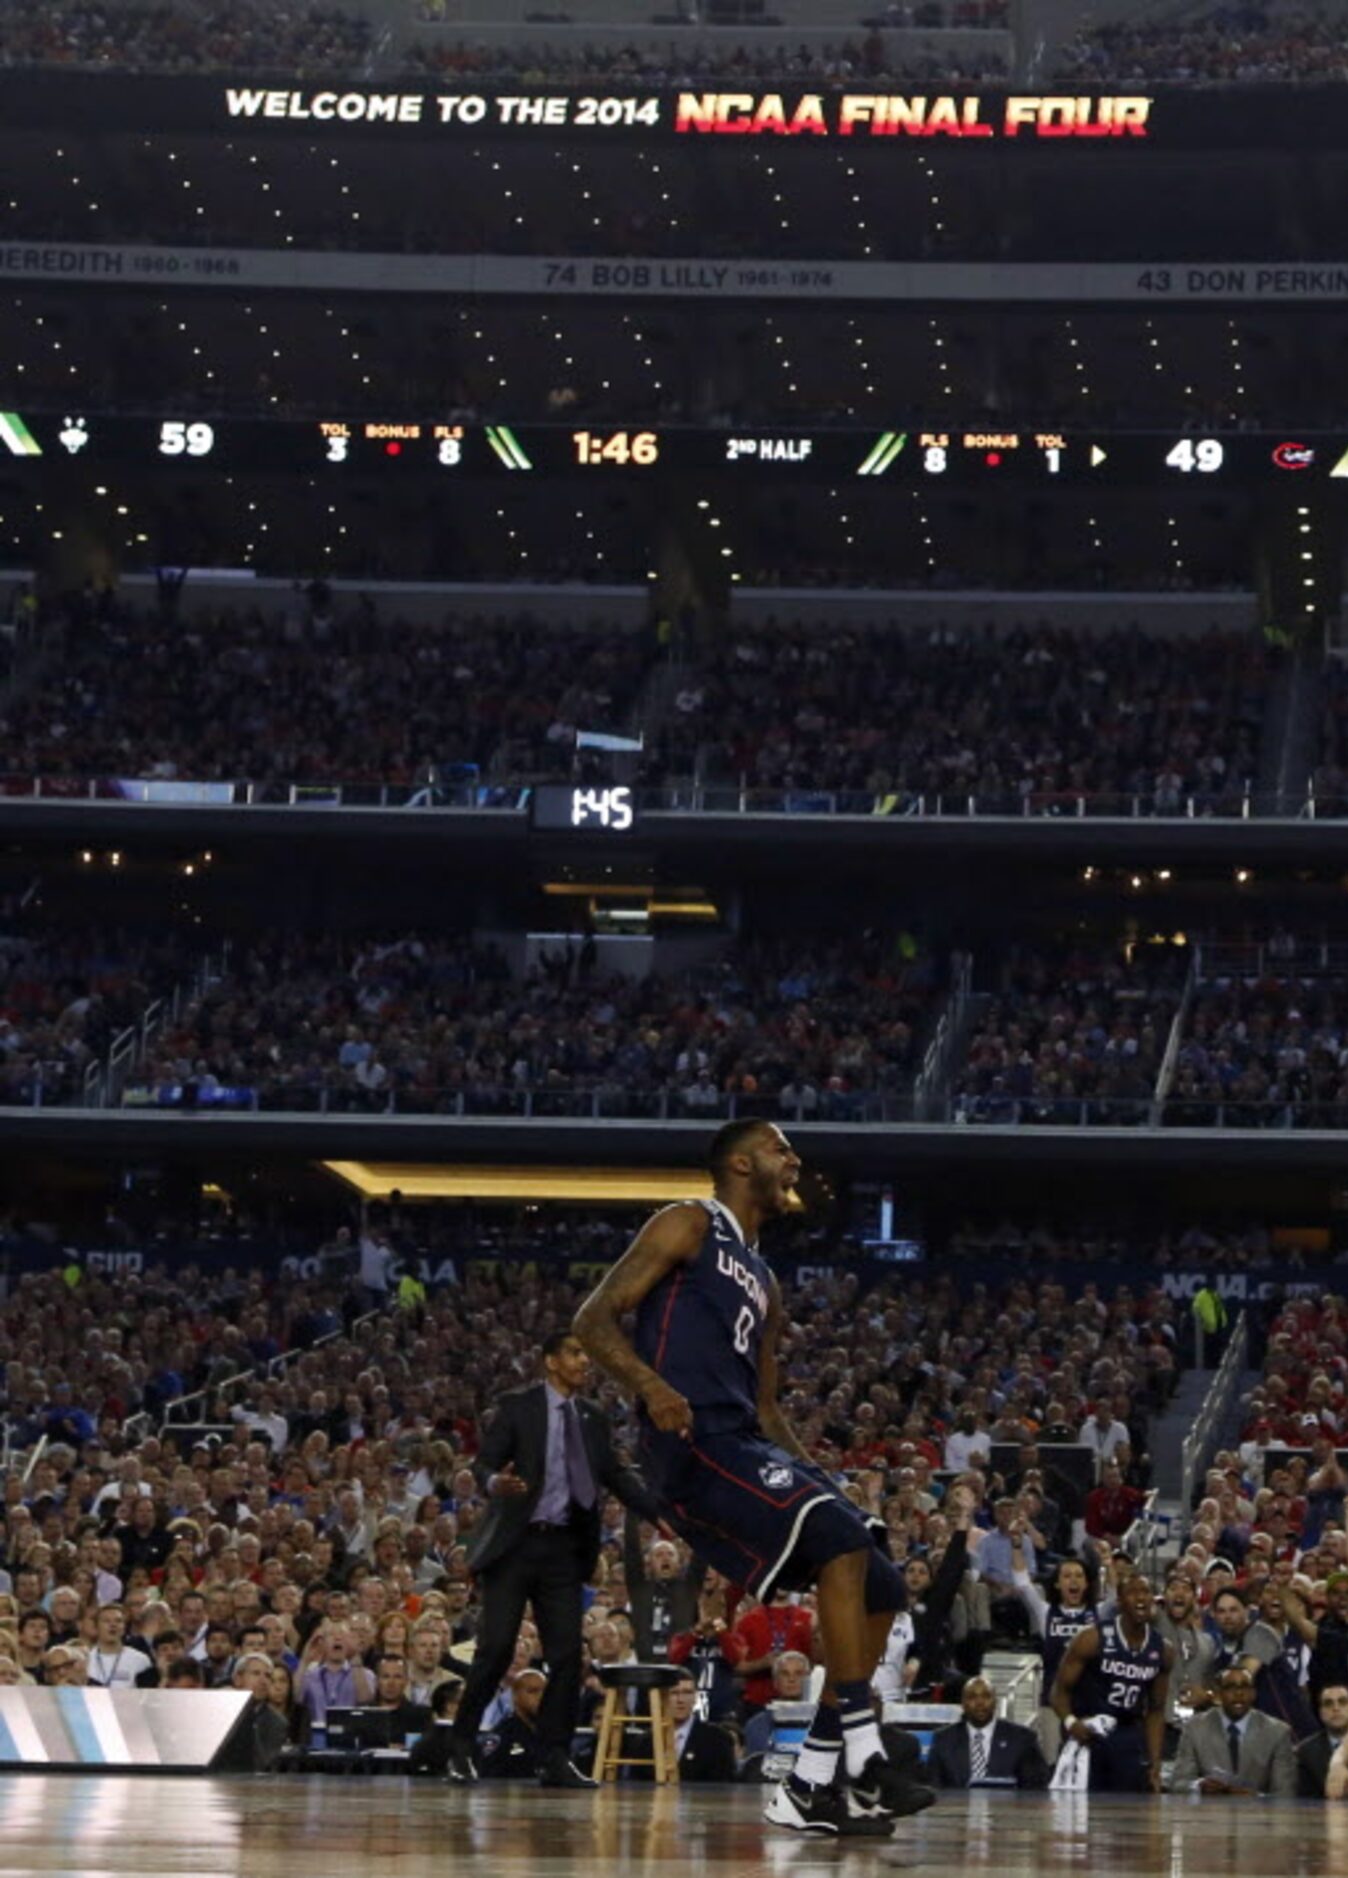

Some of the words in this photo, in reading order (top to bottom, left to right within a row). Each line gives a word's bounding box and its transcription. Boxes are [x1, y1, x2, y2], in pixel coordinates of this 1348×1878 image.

[226, 89, 424, 122] WELCOME
[437, 95, 487, 124] TO
[496, 96, 569, 124] THE
[573, 96, 660, 127] 2014
[675, 93, 828, 135] NCAA
[838, 94, 994, 137] FINAL
[1004, 96, 1154, 137] FOUR
[545, 264, 577, 286] 74
[592, 264, 651, 287] BOB
[660, 265, 728, 288] LILLY
[1137, 270, 1171, 292] 43
[1187, 270, 1245, 292] DON
[159, 422, 214, 456] 59
[320, 423, 351, 437] TOL
[365, 424, 420, 439] BONUS
[963, 433, 1019, 448] BONUS
[1035, 433, 1067, 447] TOL
[326, 437, 348, 462] 3
[438, 439, 461, 465] 8
[573, 431, 659, 465] 1:46
[726, 438, 756, 459] 2ND
[760, 439, 812, 461] HALF
[924, 447, 947, 473] 8
[1045, 448, 1060, 473] 1
[1165, 439, 1224, 472] 49
[571, 786, 633, 830] 1:45
[734, 1304, 755, 1355] 0
[1101, 1658, 1160, 1680] UCONN
[1107, 1681, 1141, 1709] 20
